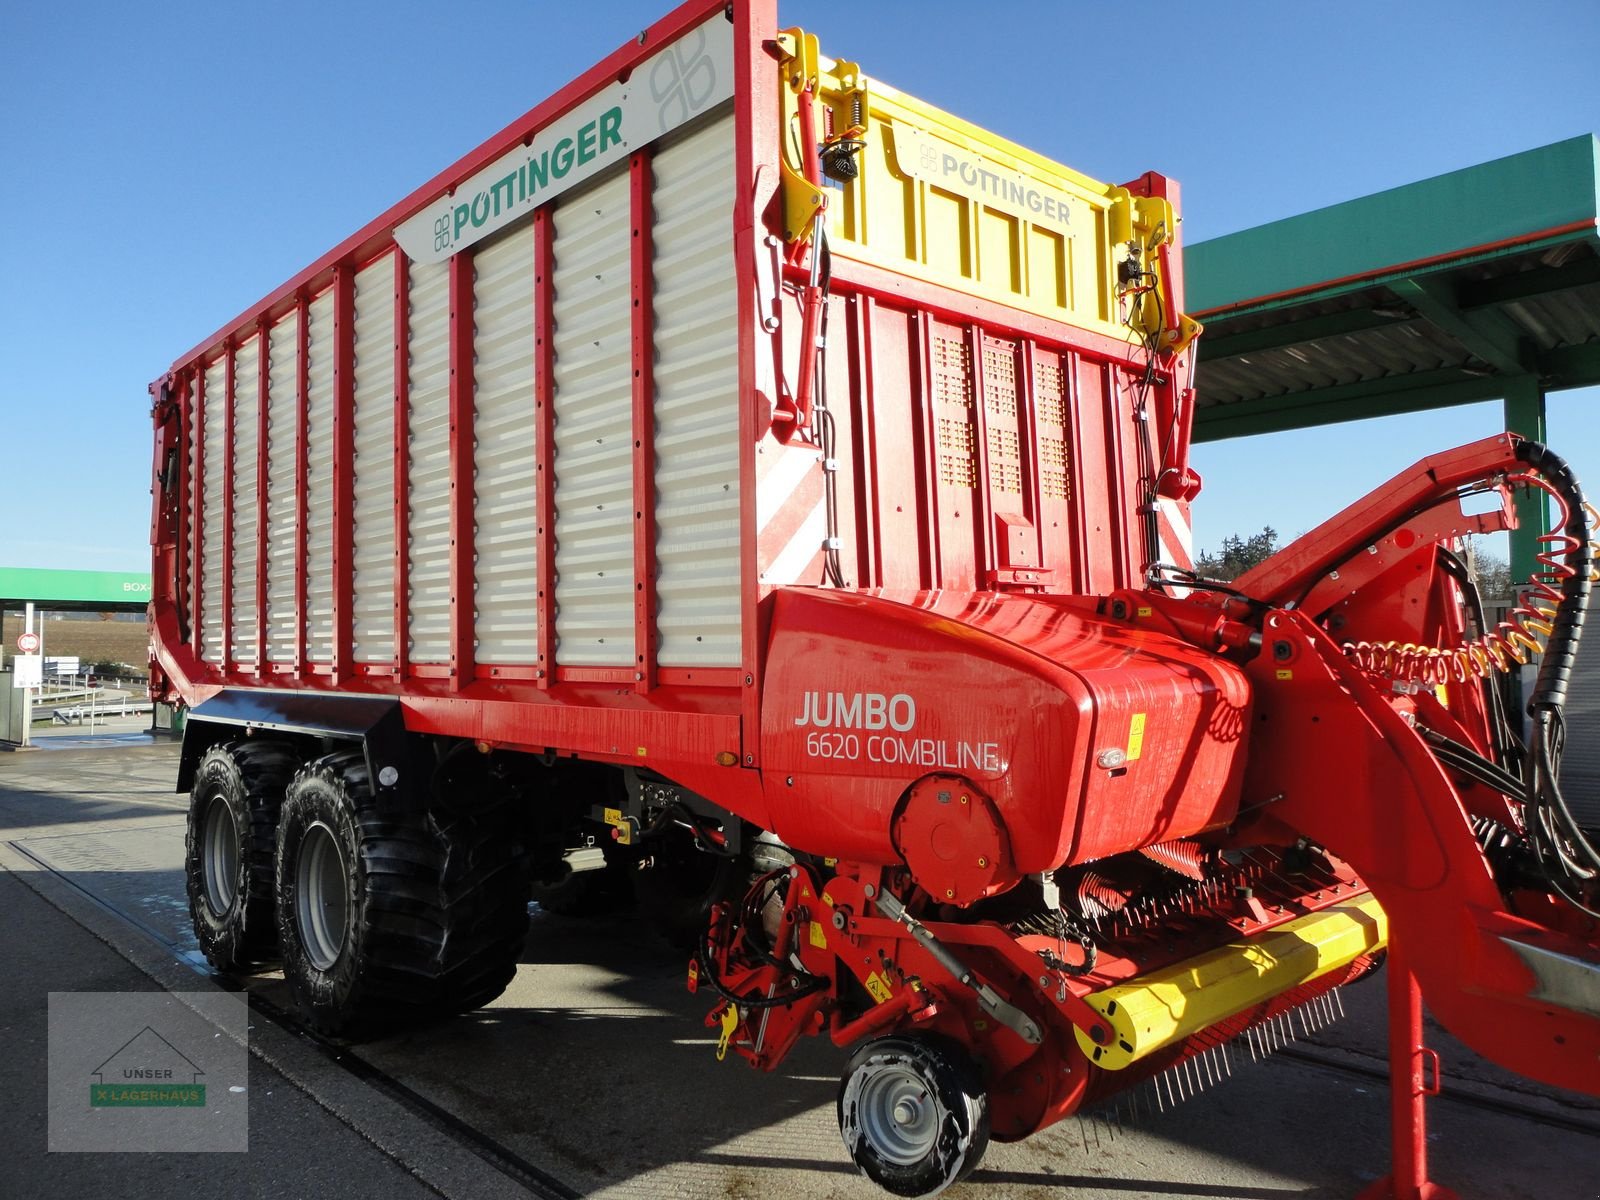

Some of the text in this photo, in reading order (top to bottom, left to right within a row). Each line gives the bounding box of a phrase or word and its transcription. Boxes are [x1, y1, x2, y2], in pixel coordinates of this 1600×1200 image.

[454, 106, 623, 241] PÖTTINGER
[942, 153, 1071, 226] PÖTTINGER
[795, 691, 916, 732] JUMBO
[807, 732, 998, 771] 6620 COMBILINE
